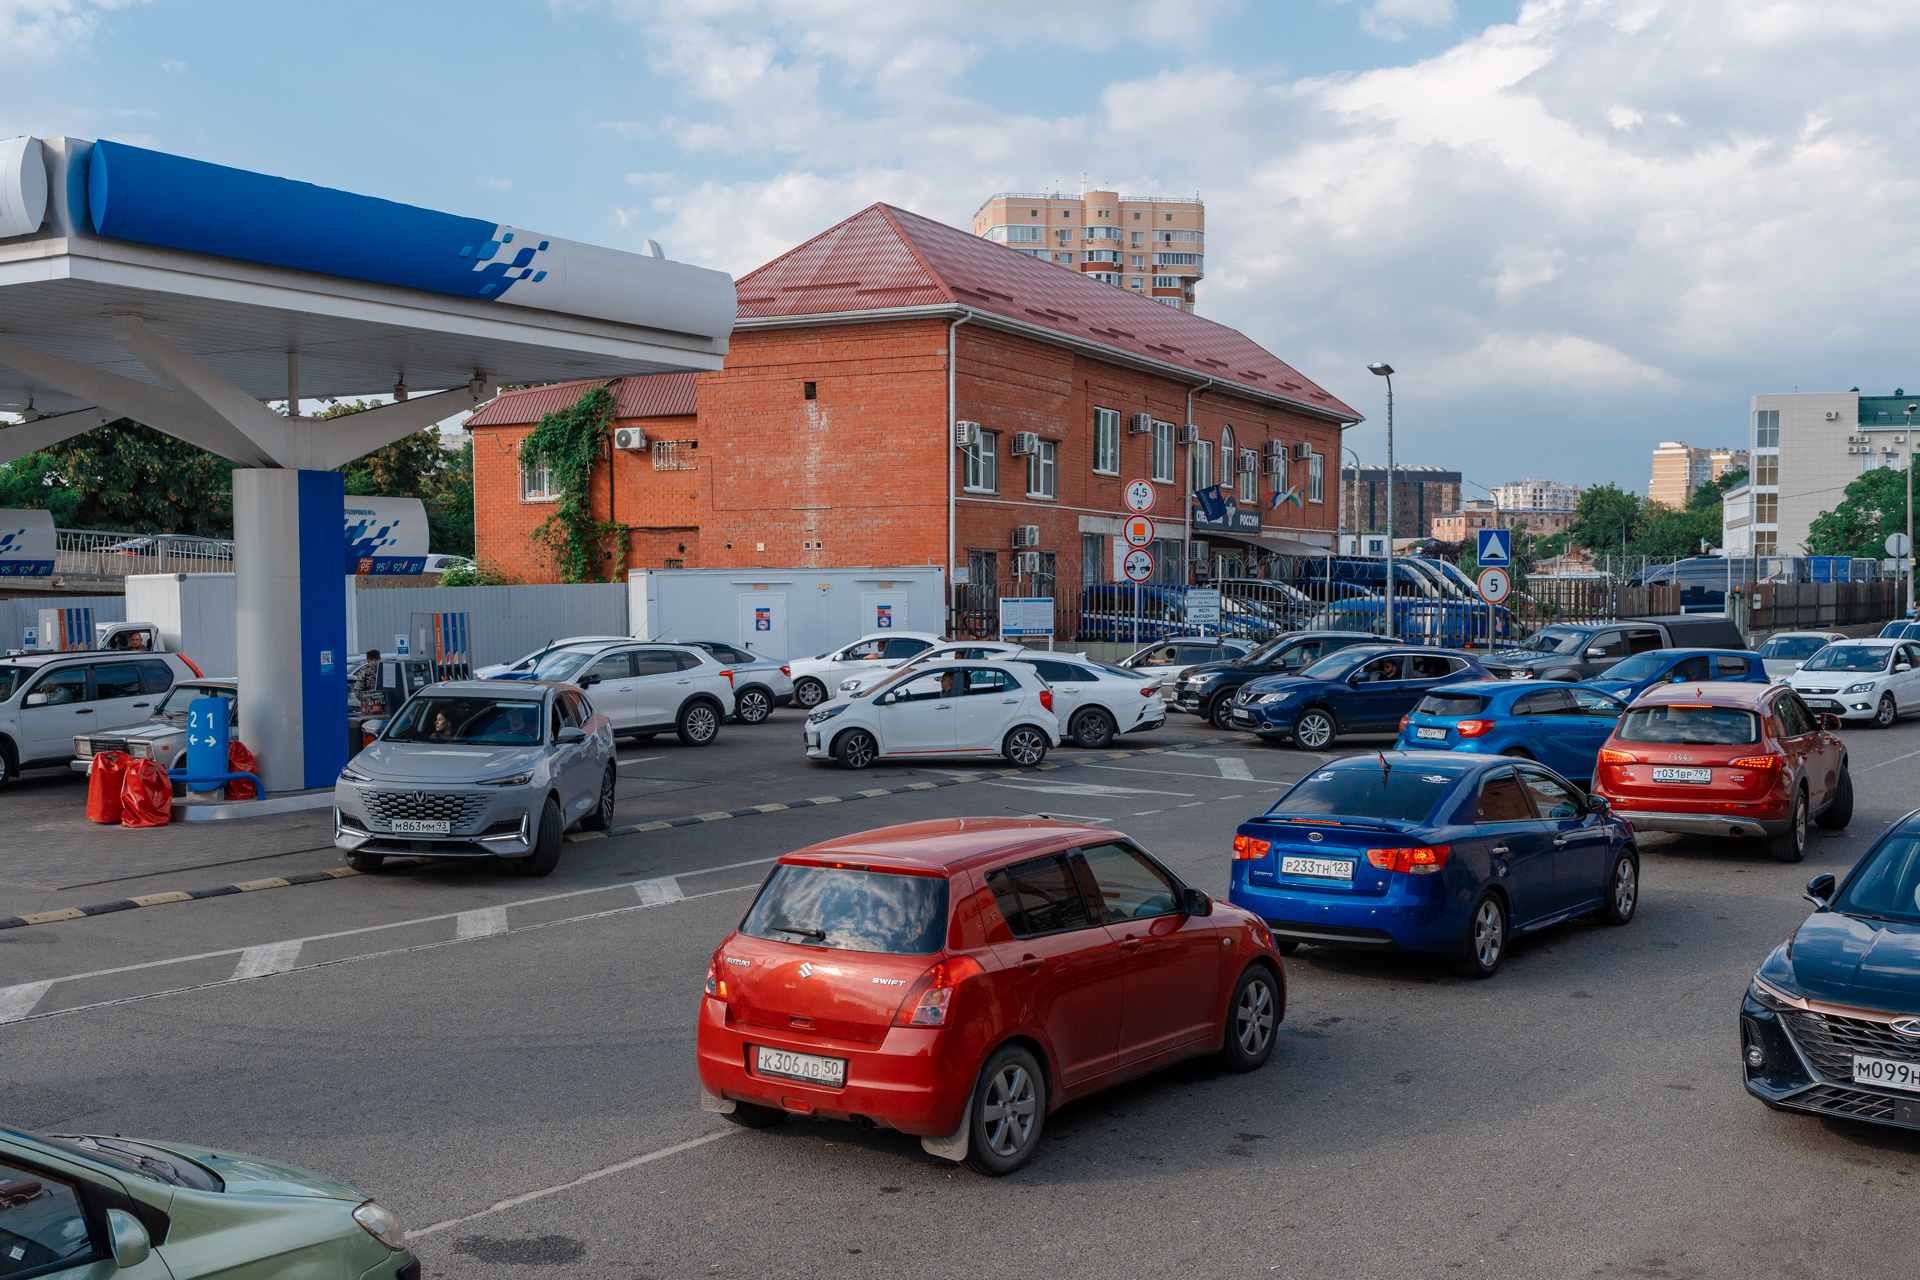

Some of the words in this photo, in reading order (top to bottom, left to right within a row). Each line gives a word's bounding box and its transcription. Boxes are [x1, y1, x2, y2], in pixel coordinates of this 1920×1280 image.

[1132, 487, 1148, 499] 4,5
[1239, 513, 1260, 528] РОССИИ
[393, 562, 403, 573] 92
[1490, 578, 1499, 593] 5
[190, 711, 197, 728] 2
[206, 712, 214, 729] 1
[395, 821, 435, 832] М863ММ
[436, 821, 447, 830] 93
[1285, 860, 1330, 875] Р233ТН
[1332, 861, 1350, 873] 123
[871, 977, 906, 987] SWIFT
[763, 1052, 819, 1077] К306АВ
[823, 1060, 839, 1075] 50
[1857, 1061, 1920, 1085] М099Н
